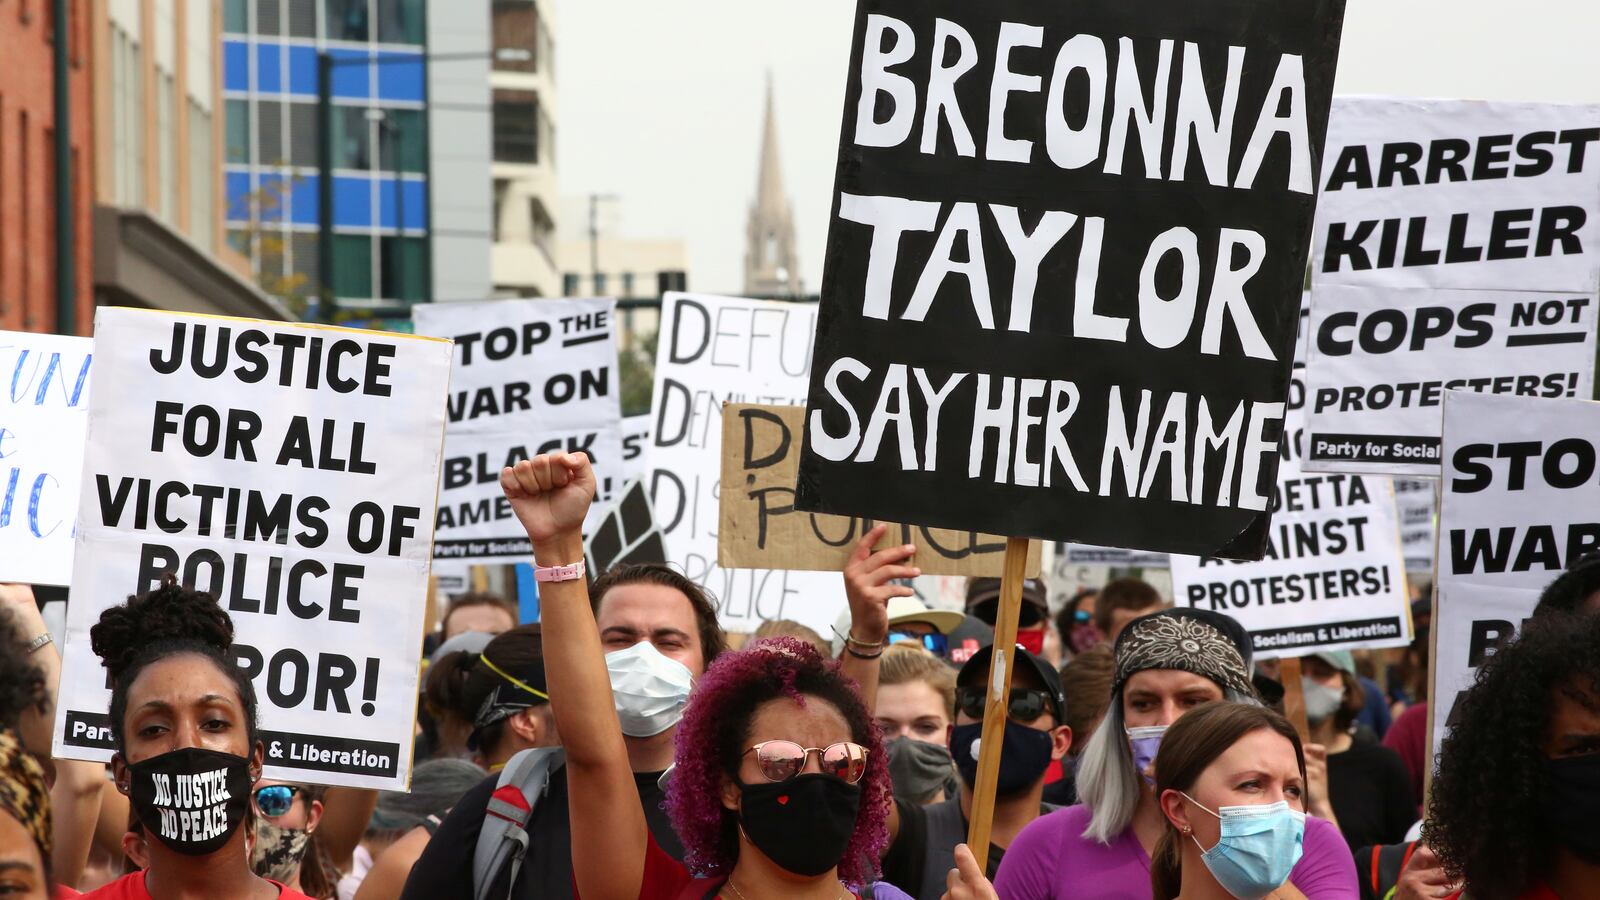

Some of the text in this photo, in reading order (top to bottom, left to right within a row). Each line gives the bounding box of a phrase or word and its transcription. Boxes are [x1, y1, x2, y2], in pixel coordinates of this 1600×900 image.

[854, 14, 1314, 194] BREONNA
[1324, 127, 1600, 192] ARREST
[1322, 205, 1587, 273] KILLER
[839, 191, 1277, 361] TAYLOR
[453, 311, 608, 366] TOP THE
[1316, 303, 1497, 356] COPS
[1510, 298, 1590, 327] NOT
[150, 322, 396, 397] JUSTICE
[544, 367, 609, 405] ON
[151, 401, 377, 474] FOR ALL
[809, 356, 970, 471] SAY
[968, 373, 1090, 492] HER
[1099, 385, 1286, 511] NAME
[1316, 440, 1361, 460] Party
[1365, 441, 1388, 456] for
[1393, 442, 1440, 459] Social
[1452, 438, 1600, 493] STO
[96, 474, 421, 556] VICTIMS OF
[469, 542, 485, 554] for
[1187, 565, 1391, 611] PROTESTERS!
[1253, 623, 1397, 648] Socialism & Liberation
[268, 741, 283, 758] &
[290, 743, 390, 770] Liberation
[152, 767, 231, 808] NO JUSTICE
[157, 802, 229, 842] NO PEACE
